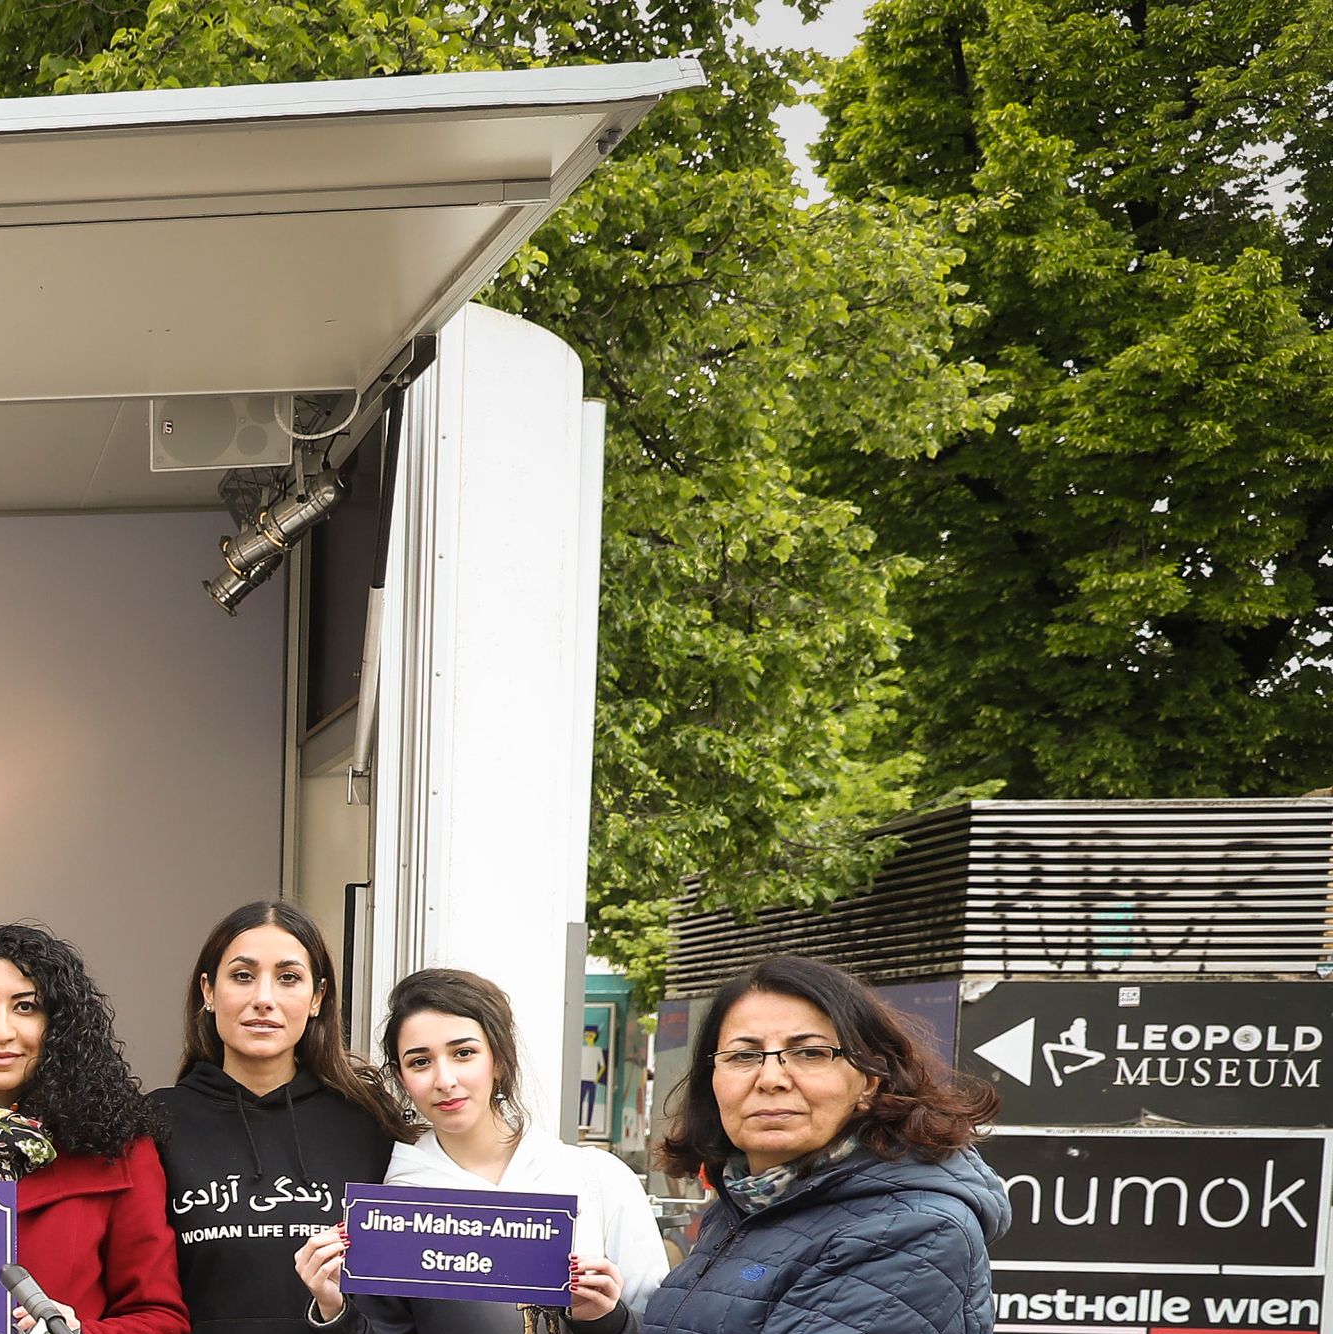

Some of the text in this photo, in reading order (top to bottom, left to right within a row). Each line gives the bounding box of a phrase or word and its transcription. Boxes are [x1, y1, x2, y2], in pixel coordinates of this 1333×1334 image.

[1116, 1024, 1323, 1052] LEOPOLD
[1112, 1057, 1322, 1088] MUSEUM
[172, 1174, 333, 1215] زندگی آزادی
[181, 1224, 243, 1245] WOMAN
[247, 1224, 284, 1238] LIFE
[360, 1207, 562, 1241] Jina-Mahsa-Amini-
[421, 1249, 493, 1276] Straße
